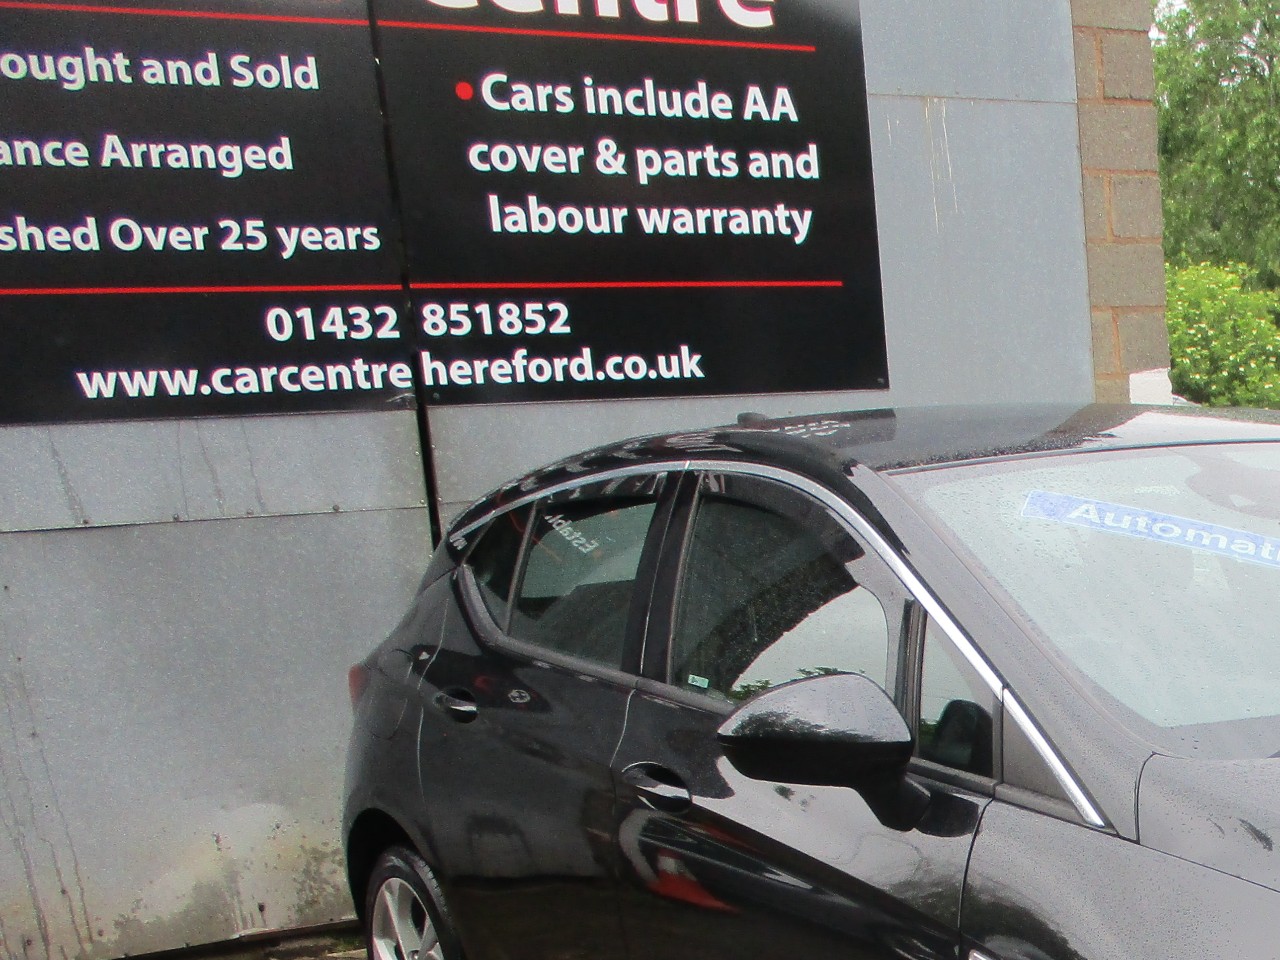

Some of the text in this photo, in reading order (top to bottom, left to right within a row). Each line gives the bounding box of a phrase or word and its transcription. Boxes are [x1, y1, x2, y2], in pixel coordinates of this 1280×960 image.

[142, 53, 222, 87] and
[230, 55, 321, 90] Sold
[480, 73, 799, 123] Cars include AA
[101, 134, 294, 178] Arranged
[468, 138, 820, 185] cover & parts and
[110, 218, 210, 252] Over
[218, 220, 268, 252] 25
[277, 225, 381, 260] years
[488, 194, 813, 245] labour warranty
[265, 302, 571, 342] 01432 851852
